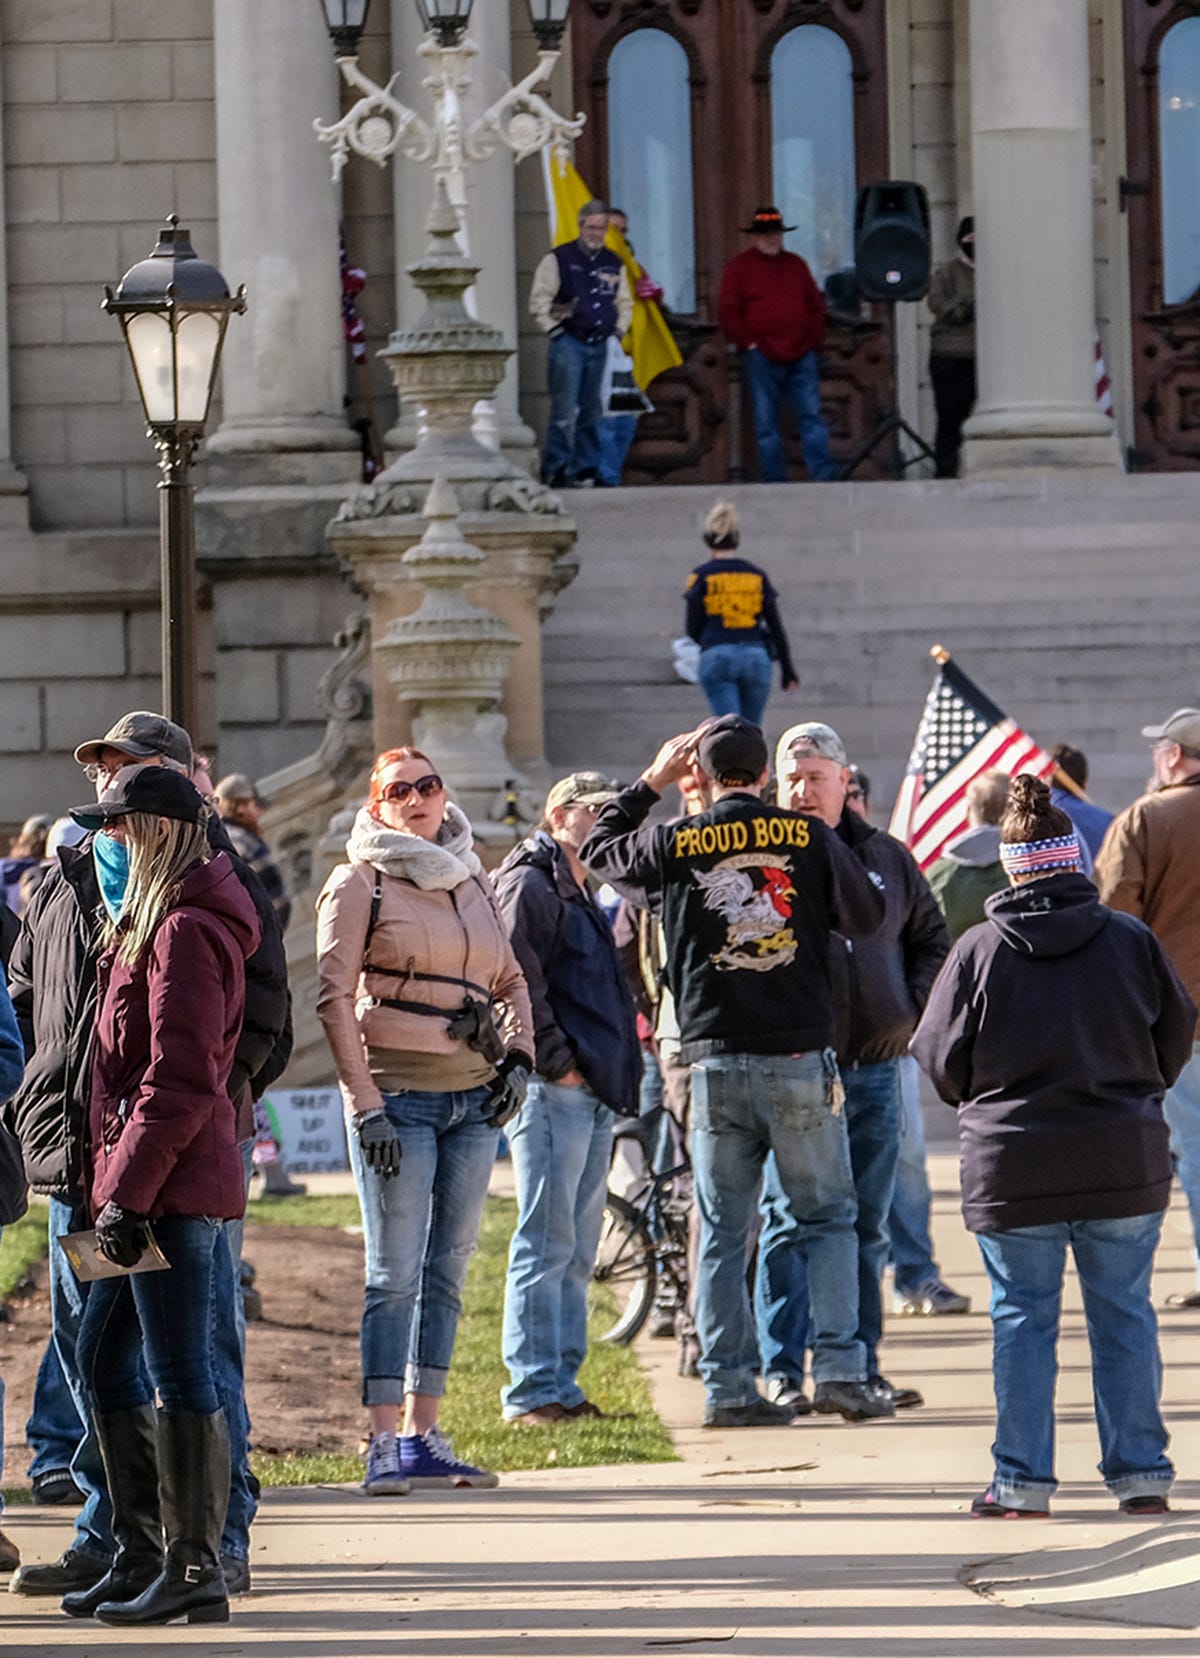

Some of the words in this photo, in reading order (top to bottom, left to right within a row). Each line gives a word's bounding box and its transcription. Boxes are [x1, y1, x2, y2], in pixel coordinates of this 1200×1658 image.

[676, 820, 748, 858] PROUD
[752, 817, 810, 848] BOYS
[730, 855, 775, 867] PROUD
[290, 1094, 332, 1110] SHUT
[302, 1116, 325, 1132] UP
[297, 1138, 331, 1154] AND
